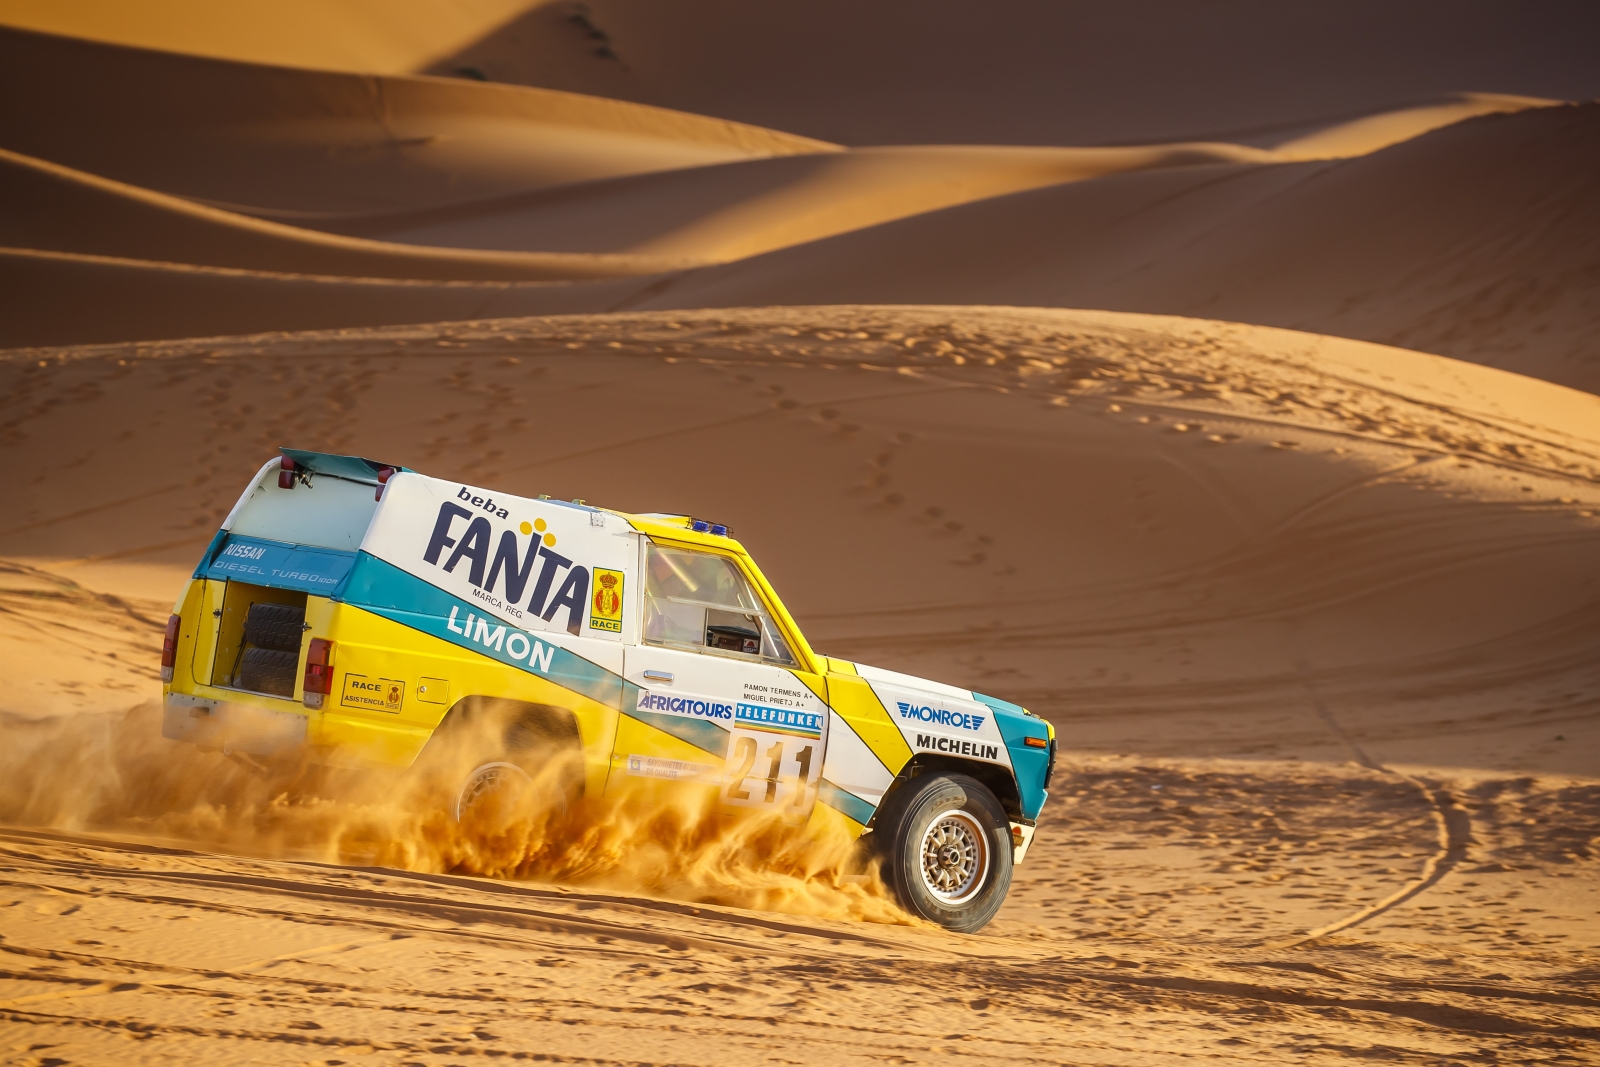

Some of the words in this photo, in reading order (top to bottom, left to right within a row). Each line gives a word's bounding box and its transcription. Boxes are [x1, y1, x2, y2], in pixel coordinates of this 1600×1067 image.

[457, 487, 509, 520] beba
[223, 544, 267, 560] NISSAN
[214, 561, 265, 575] DIESEL
[271, 569, 319, 583] TURBO
[423, 501, 590, 637] FANTA
[472, 588, 502, 609] MARCA
[505, 604, 523, 620] REG.
[592, 619, 620, 630] RACE
[446, 605, 555, 674] LIMON
[352, 681, 382, 692] RACE
[743, 693, 768, 703] MIGUEL
[744, 683, 768, 693] RAMON
[770, 687, 802, 698] TERMENS
[344, 695, 385, 706] ASISTENCIA
[637, 693, 733, 720] AFRICATOURS
[737, 705, 823, 729] TELEFUNKEN
[907, 704, 972, 730] MONROE
[916, 733, 998, 760] MICHELIN
[727, 736, 813, 808] 211
